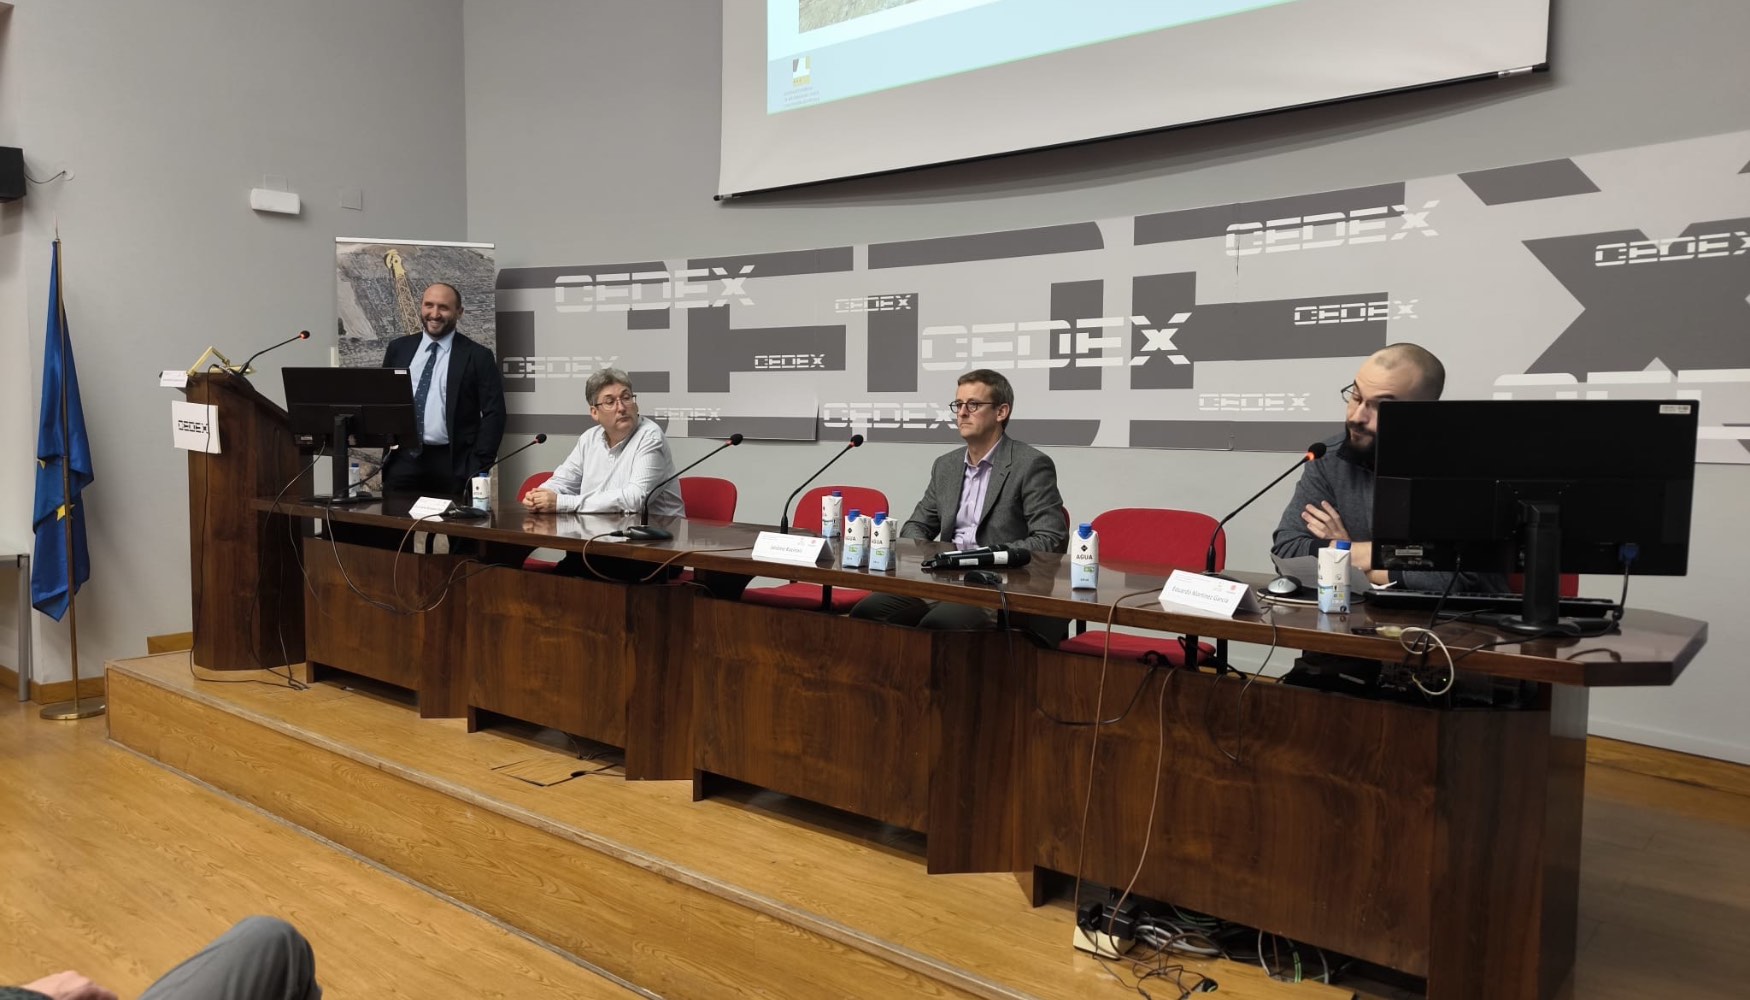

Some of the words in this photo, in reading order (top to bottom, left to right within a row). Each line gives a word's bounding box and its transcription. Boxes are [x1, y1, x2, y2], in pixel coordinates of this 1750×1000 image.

[1226, 200, 1440, 256] CEDEX
[555, 265, 755, 312] CEDEX
[835, 295, 911, 313] CEDEX
[1294, 299, 1419, 325] CEDEX
[921, 312, 1192, 371] CEDEX
[754, 354, 825, 368] CEDEX
[1199, 393, 1310, 411] CEDEX
[655, 407, 721, 421] CEDEX
[178, 420, 209, 434] CEDEX
